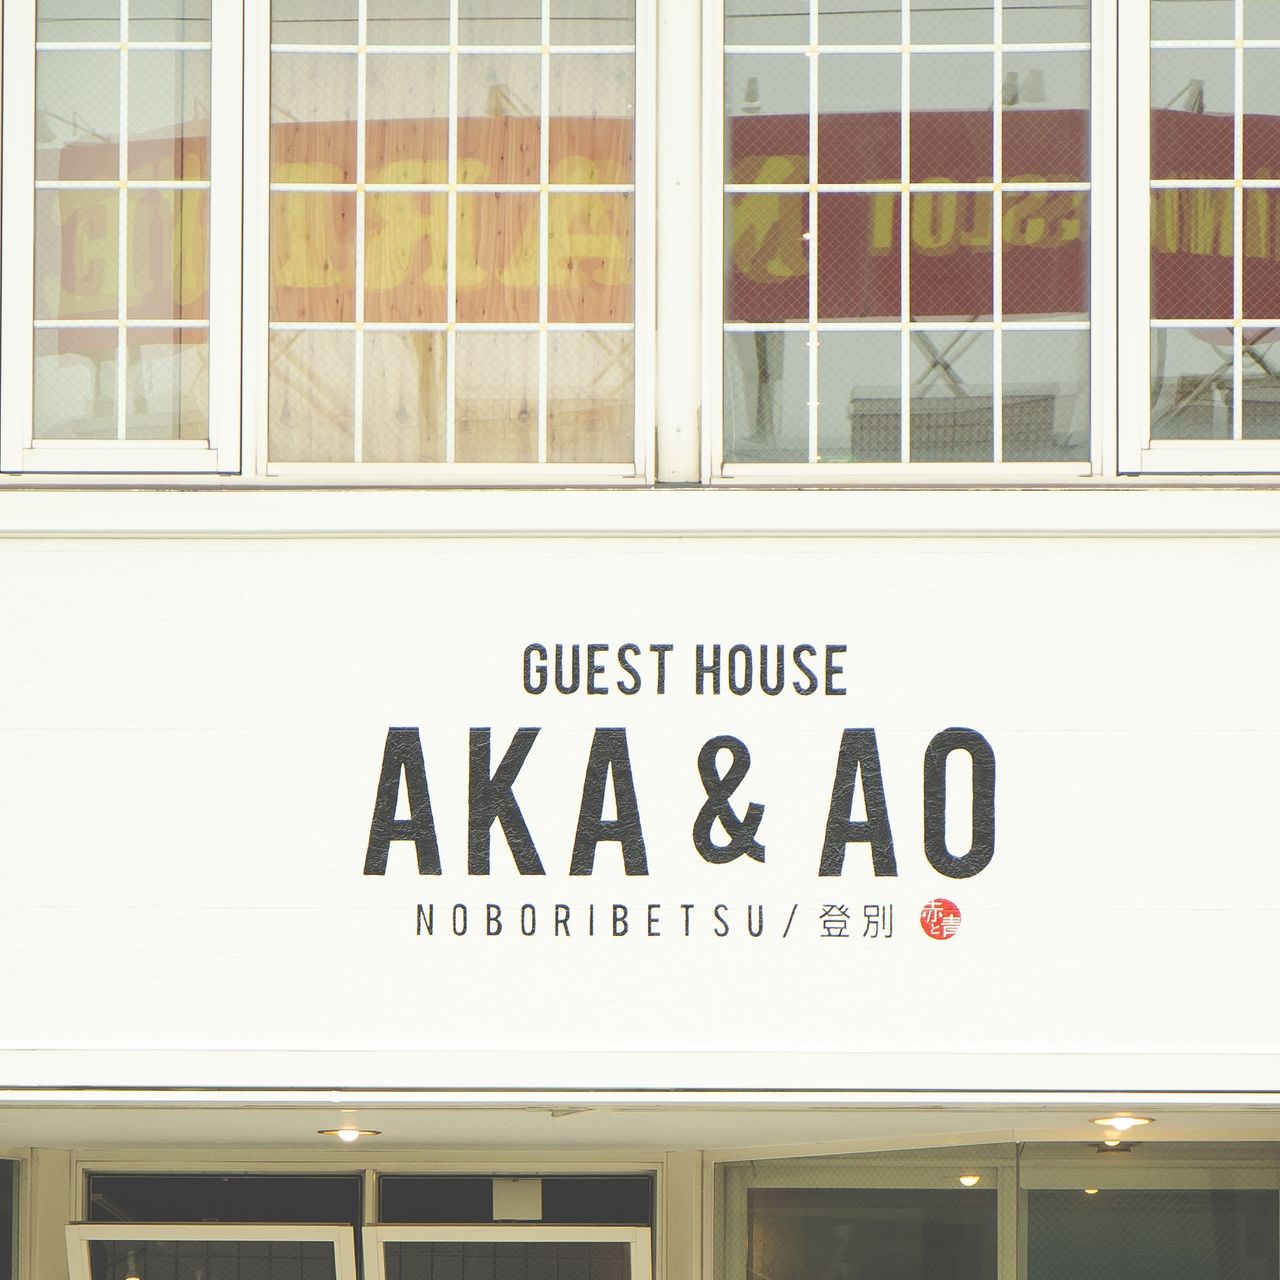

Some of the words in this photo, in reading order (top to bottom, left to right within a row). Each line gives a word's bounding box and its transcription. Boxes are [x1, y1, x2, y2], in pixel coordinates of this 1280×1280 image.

[523, 643, 674, 696] GUEST
[695, 643, 847, 696] HOUSE
[363, 726, 650, 877] AKA
[692, 734, 766, 865] &
[818, 726, 996, 880] AO
[921, 899, 961, 939] 赤と青
